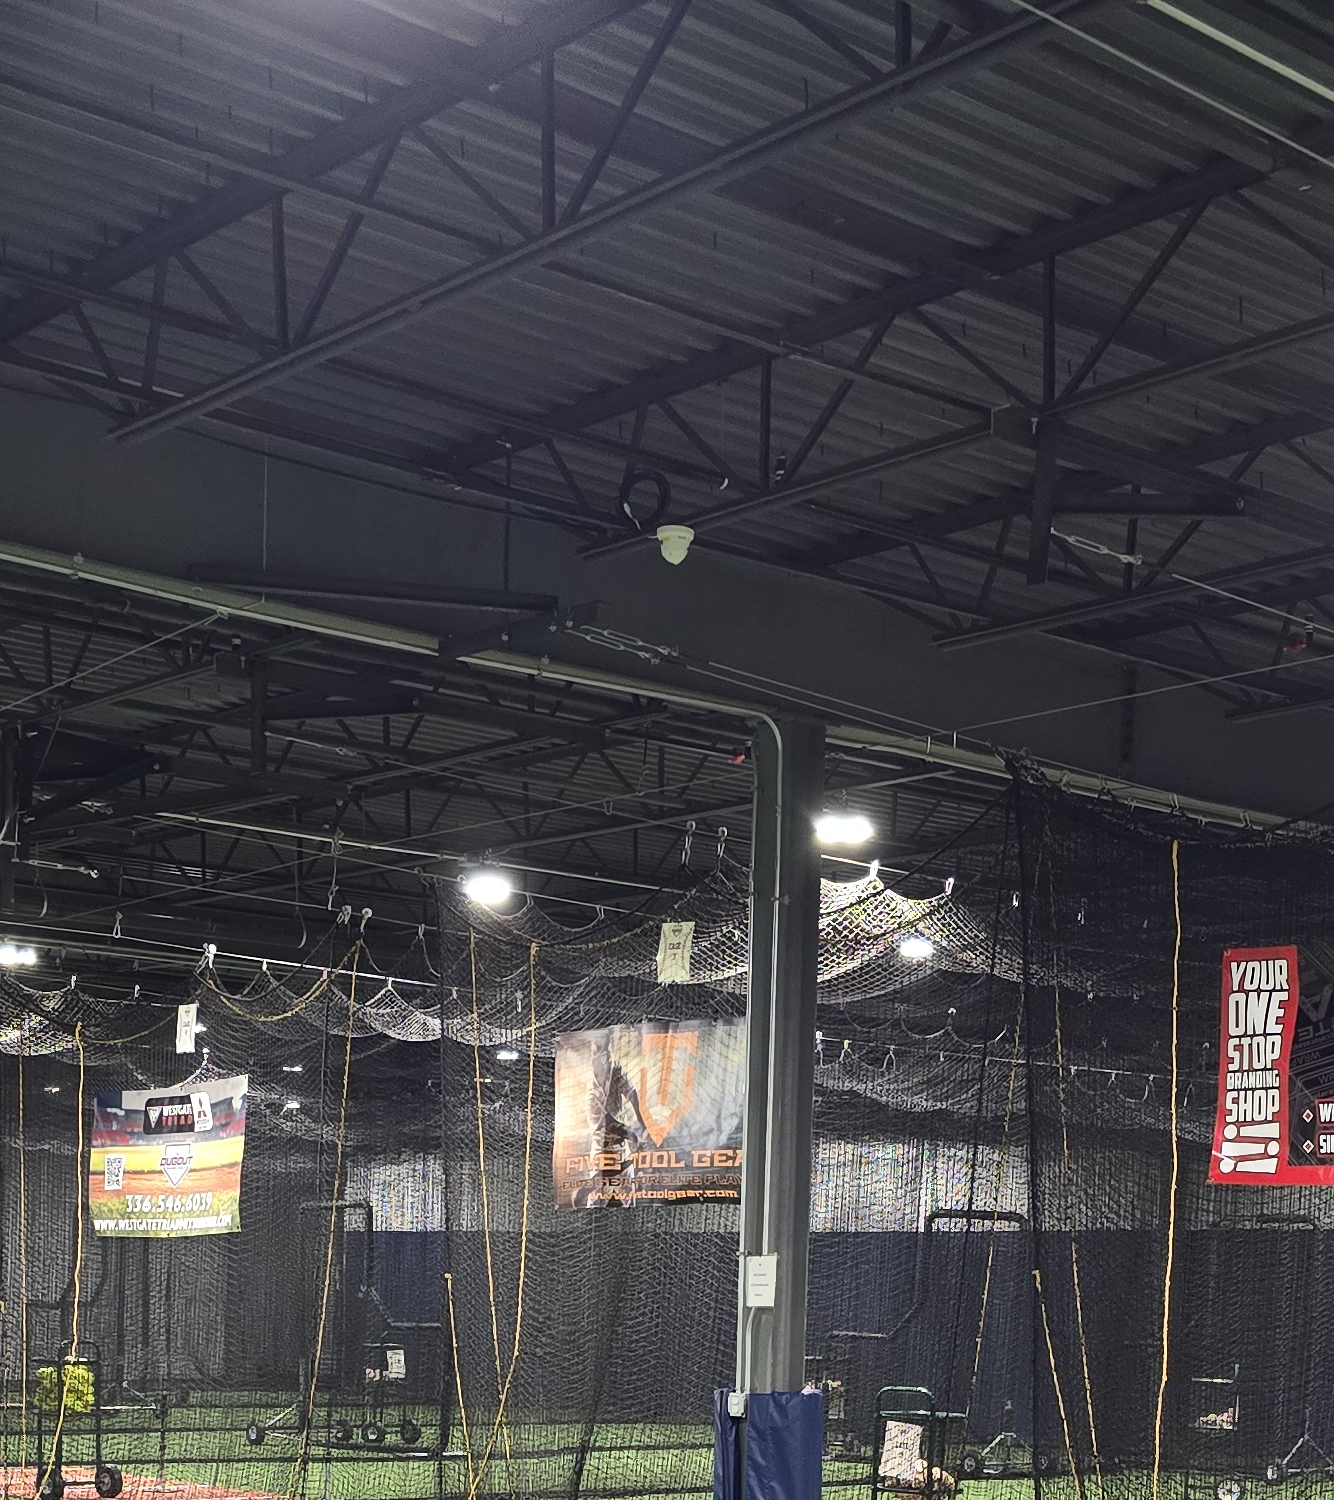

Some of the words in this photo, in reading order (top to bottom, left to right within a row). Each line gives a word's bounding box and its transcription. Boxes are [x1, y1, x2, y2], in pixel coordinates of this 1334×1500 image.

[1230, 959, 1289, 991] YOUR
[1228, 991, 1289, 1036] ONE
[1227, 1034, 1282, 1071] STOP
[1226, 1069, 1280, 1090] BRANDING
[1225, 1089, 1280, 1123] SHOP
[161, 1115, 193, 1126] TRIAD
[160, 1156, 193, 1167] DUGOUT
[566, 1152, 622, 1173] FIVE
[629, 1150, 685, 1169] TOOL
[661, 1175, 701, 1186] ELITE
[125, 1192, 213, 1213] 336.546.6039
